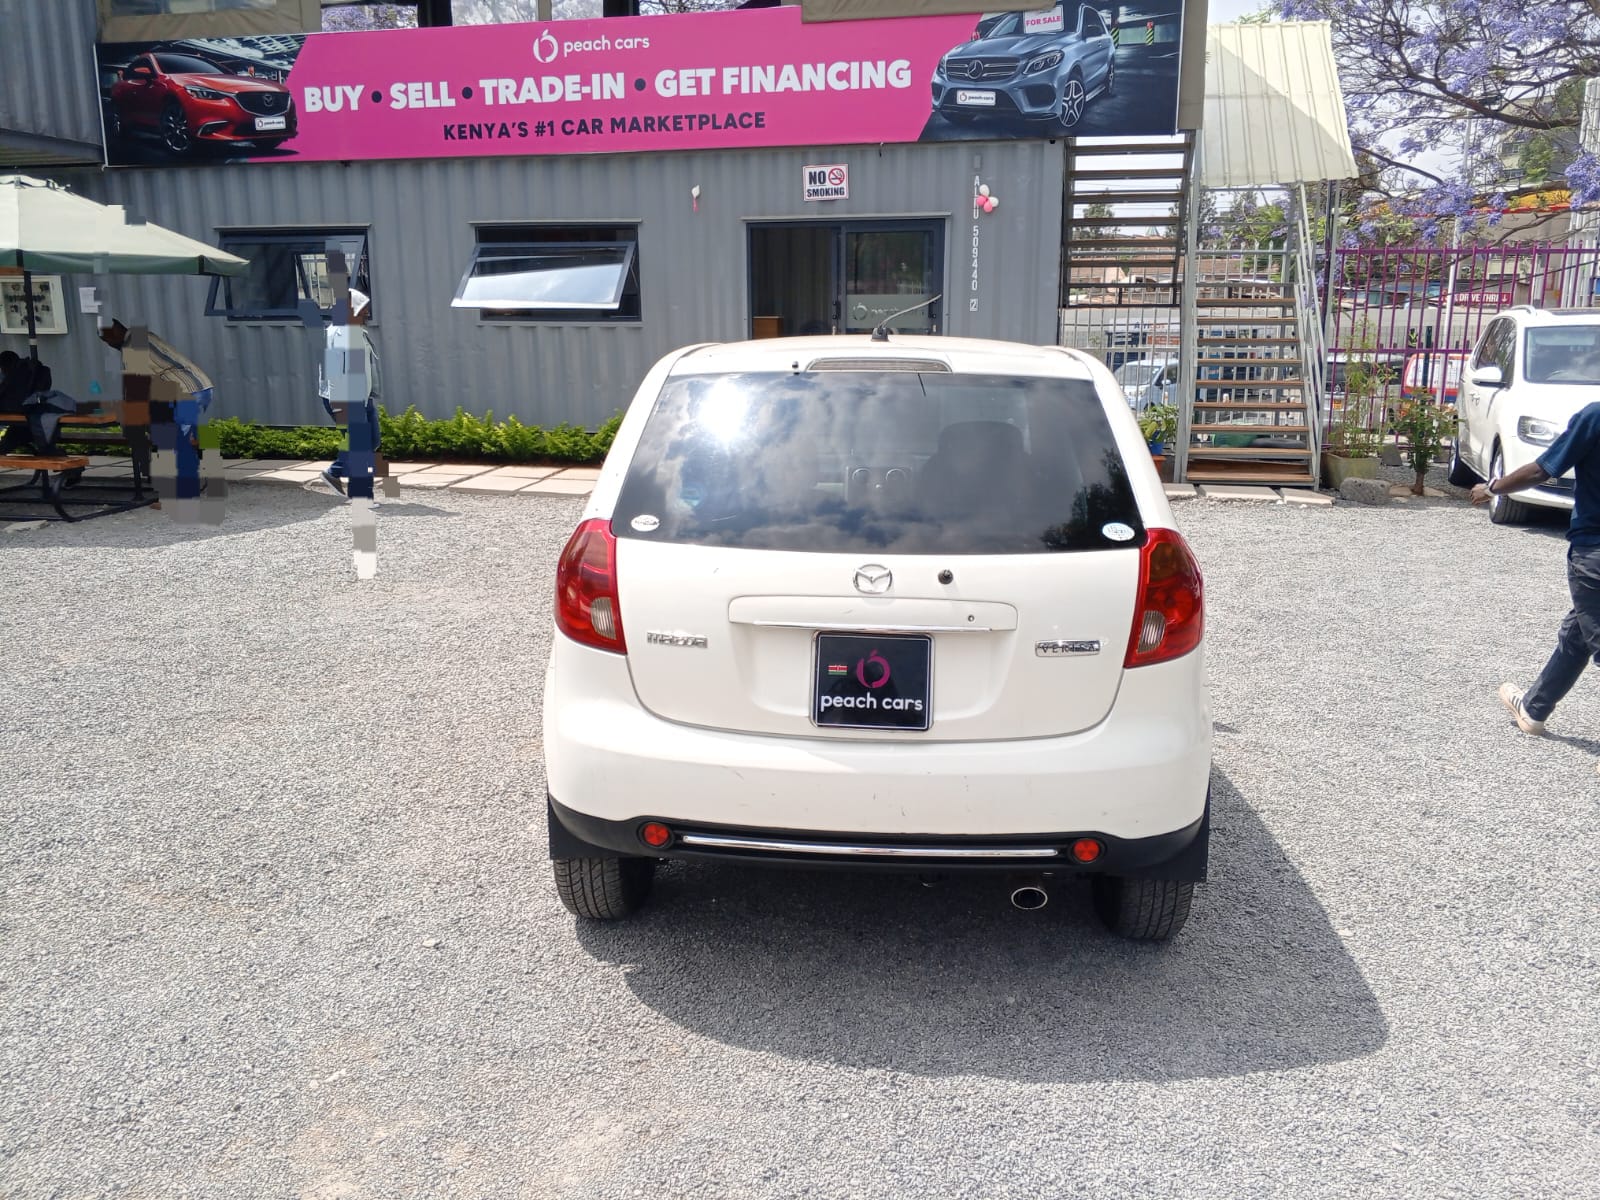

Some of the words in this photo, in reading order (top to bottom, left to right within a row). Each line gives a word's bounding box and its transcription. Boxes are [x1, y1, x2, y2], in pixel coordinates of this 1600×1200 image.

[1026, 19, 1041, 27] FOR
[1043, 15, 1062, 24] SALE
[564, 34, 611, 57] peach
[615, 37, 650, 49] cars
[304, 85, 365, 113] BUY
[389, 81, 456, 110] SELL
[479, 72, 625, 105] TRADE-IN
[654, 68, 716, 97] GET
[722, 59, 912, 94] FINANCING
[443, 121, 529, 140] KENYA'S
[535, 120, 555, 136] #1
[561, 118, 603, 135] CAR
[610, 111, 766, 134] MARKETPLACE
[808, 170, 826, 185] NO
[806, 187, 845, 197] SMOKING
[970, 299, 978, 312] 2
[820, 691, 877, 712] peach
[882, 697, 923, 711] cars
